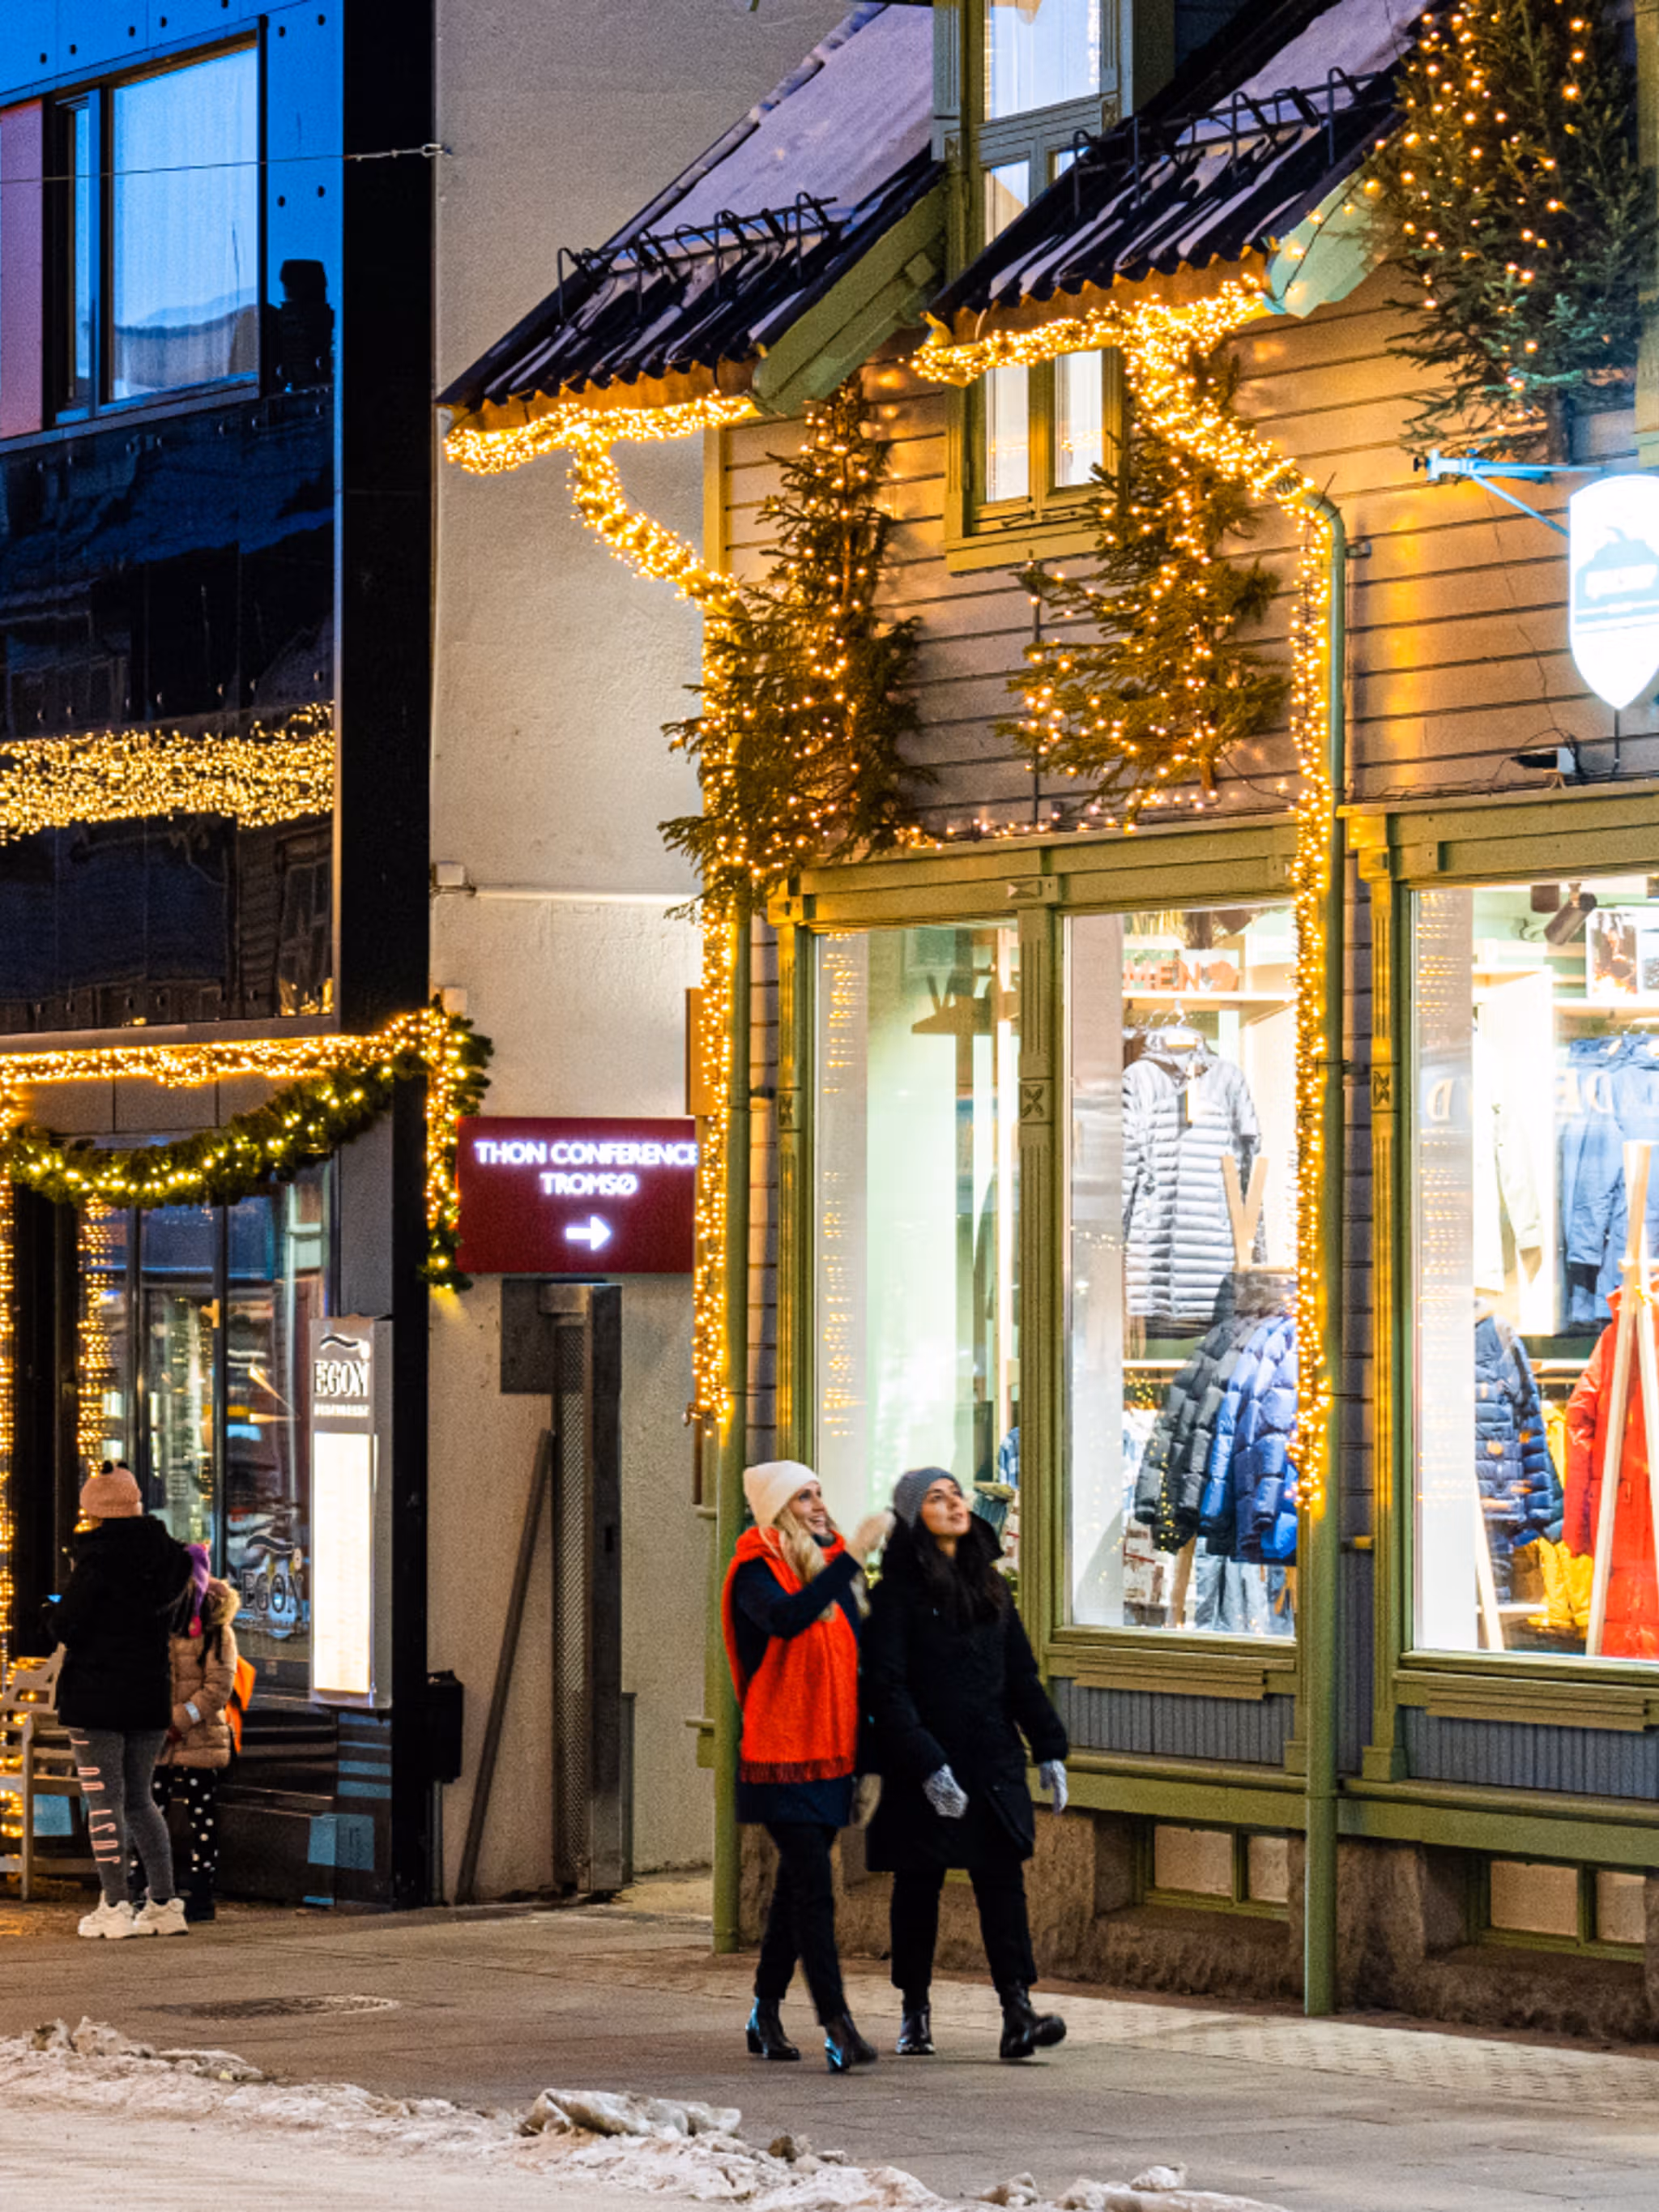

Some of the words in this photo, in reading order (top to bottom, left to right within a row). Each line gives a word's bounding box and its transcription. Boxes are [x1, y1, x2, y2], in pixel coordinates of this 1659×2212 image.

[475, 1142, 547, 1164] THON
[550, 1142, 698, 1165] CONFERENCE
[539, 1172, 638, 1195] TROMSØ
[313, 1360, 369, 1398] EGON
[242, 1571, 305, 1619] EGON
